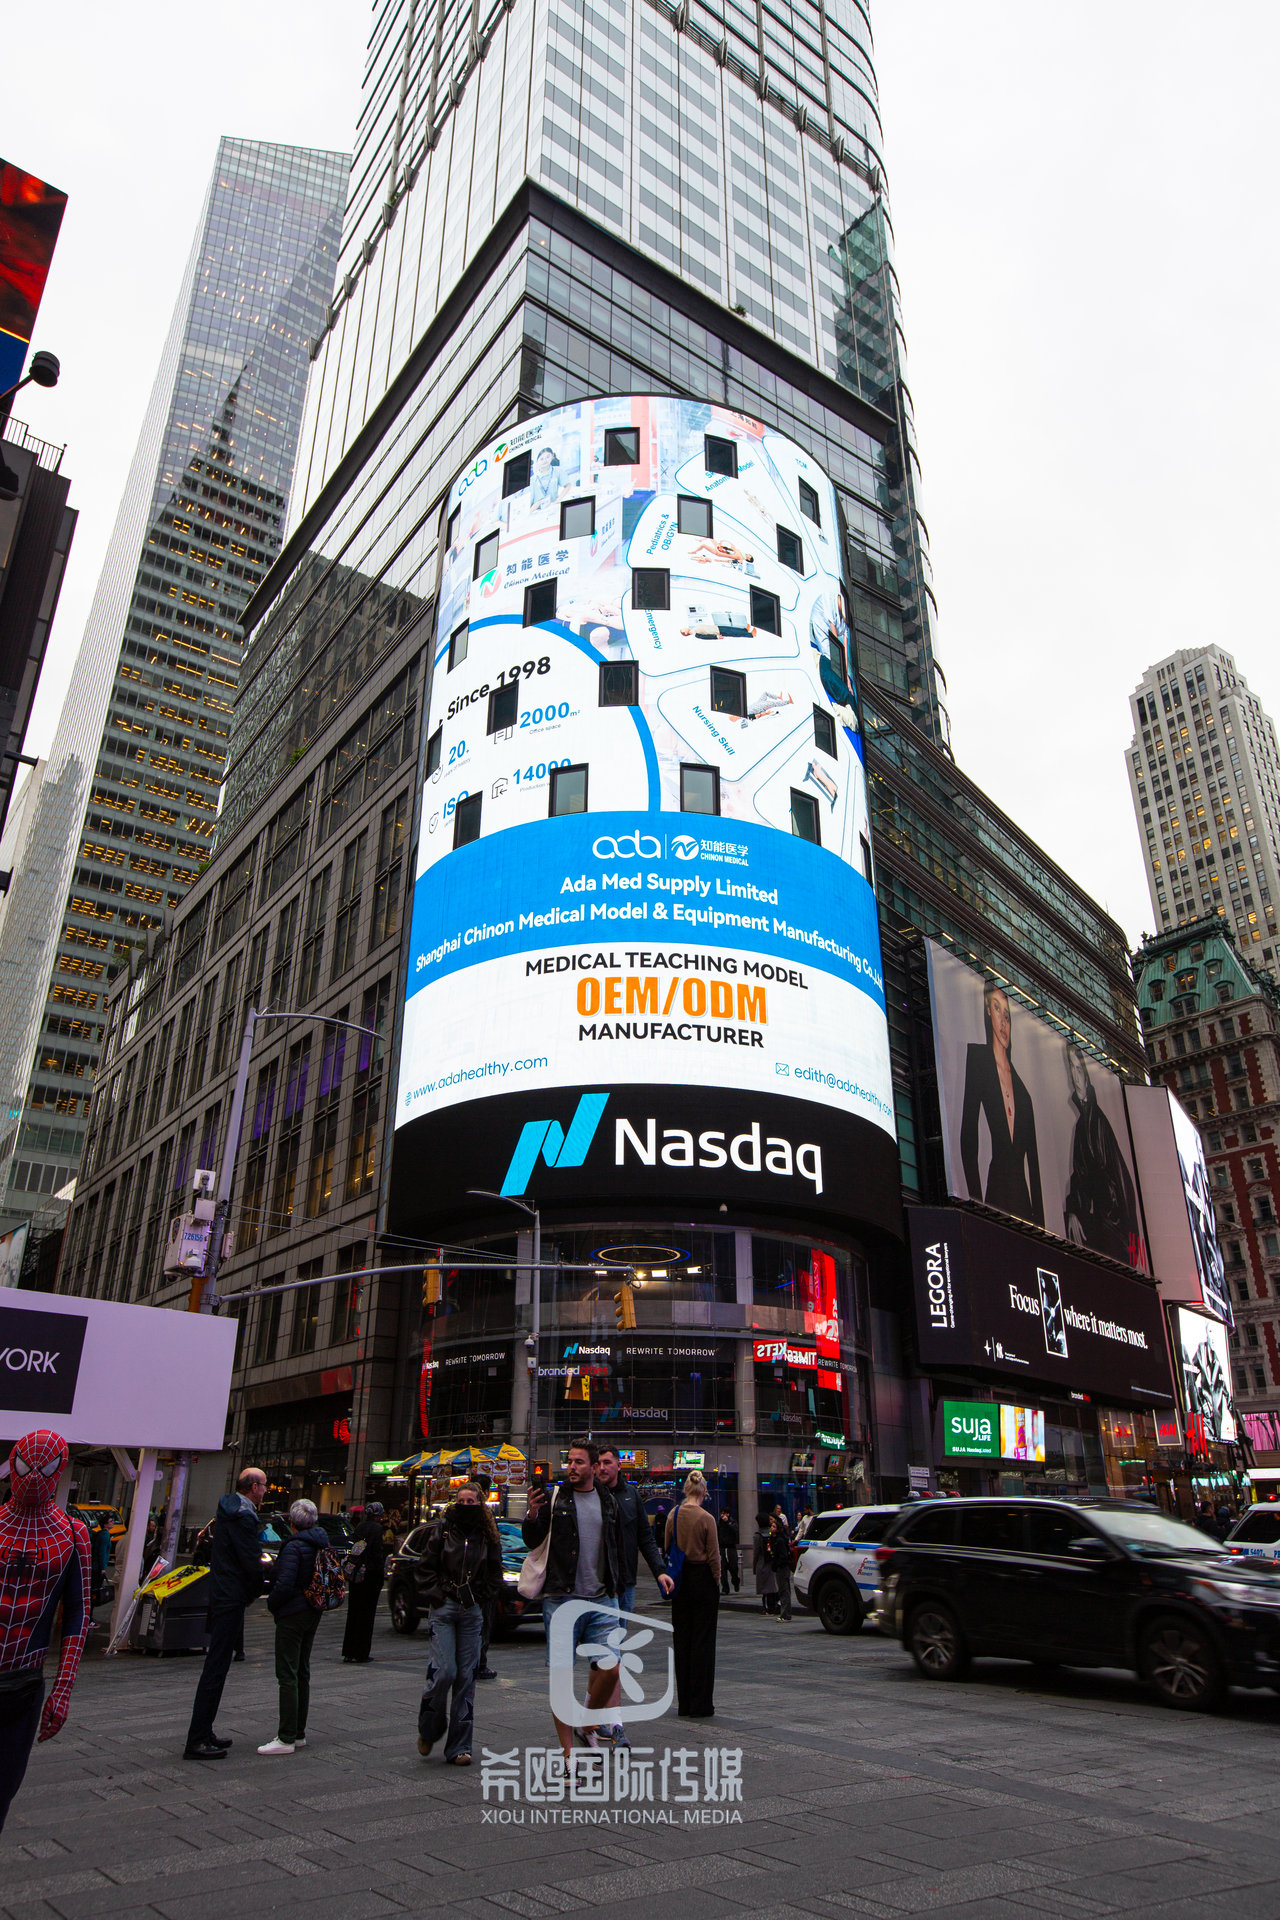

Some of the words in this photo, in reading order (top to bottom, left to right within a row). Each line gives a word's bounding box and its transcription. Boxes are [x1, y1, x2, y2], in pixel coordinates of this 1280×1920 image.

[646, 521, 668, 555] Pediatrics
[661, 513, 670, 521] &
[503, 577, 530, 590] Chinon
[532, 566, 571, 581] Medical
[506, 549, 569, 577] 知能医学
[446, 683, 490, 721] Since
[496, 656, 551, 687] 1998
[692, 705, 720, 738] Nursing
[718, 736, 736, 756] Skill
[592, 829, 662, 860] ada
[700, 839, 749, 858] 知能医学
[700, 852, 724, 863] CHINON
[724, 855, 750, 867] MEDICAL
[560, 875, 597, 895] Ada
[602, 872, 642, 890] Med
[646, 872, 711, 897] Supply
[715, 877, 779, 906] Limited
[415, 932, 462, 973] Shanghai
[463, 919, 515, 947] Chinon
[518, 904, 586, 932] Medical
[590, 902, 648, 921] Model
[652, 902, 669, 920] &
[673, 903, 770, 933] Equipment
[773, 916, 863, 974] Manufacturing
[525, 952, 622, 977] MEDICAL
[625, 951, 738, 974] TEACHING
[743, 960, 809, 990] MODEL
[577, 975, 769, 1026] OEM/ODM
[578, 1021, 765, 1049] MANUFACTURER
[413, 1056, 549, 1100] www.adahealthy.com
[615, 1118, 824, 1195] Nasdaq
[925, 1242, 948, 1328] LEGORA
[1008, 1284, 1040, 1316] Focus
[1063, 1305, 1091, 1332] where
[1089, 1311, 1098, 1335] it
[1098, 1318, 1128, 1344] matters
[1127, 1329, 1149, 1350] most.
[445, 1356, 467, 1366] REWRITE
[470, 1352, 506, 1363] TOMORROW
[579, 1345, 611, 1356] Nasdaq
[626, 1347, 664, 1355] REWRITE
[668, 1347, 716, 1356] TOMORROW
[623, 1406, 668, 1421] Nasdaq
[951, 1417, 992, 1441] suja
